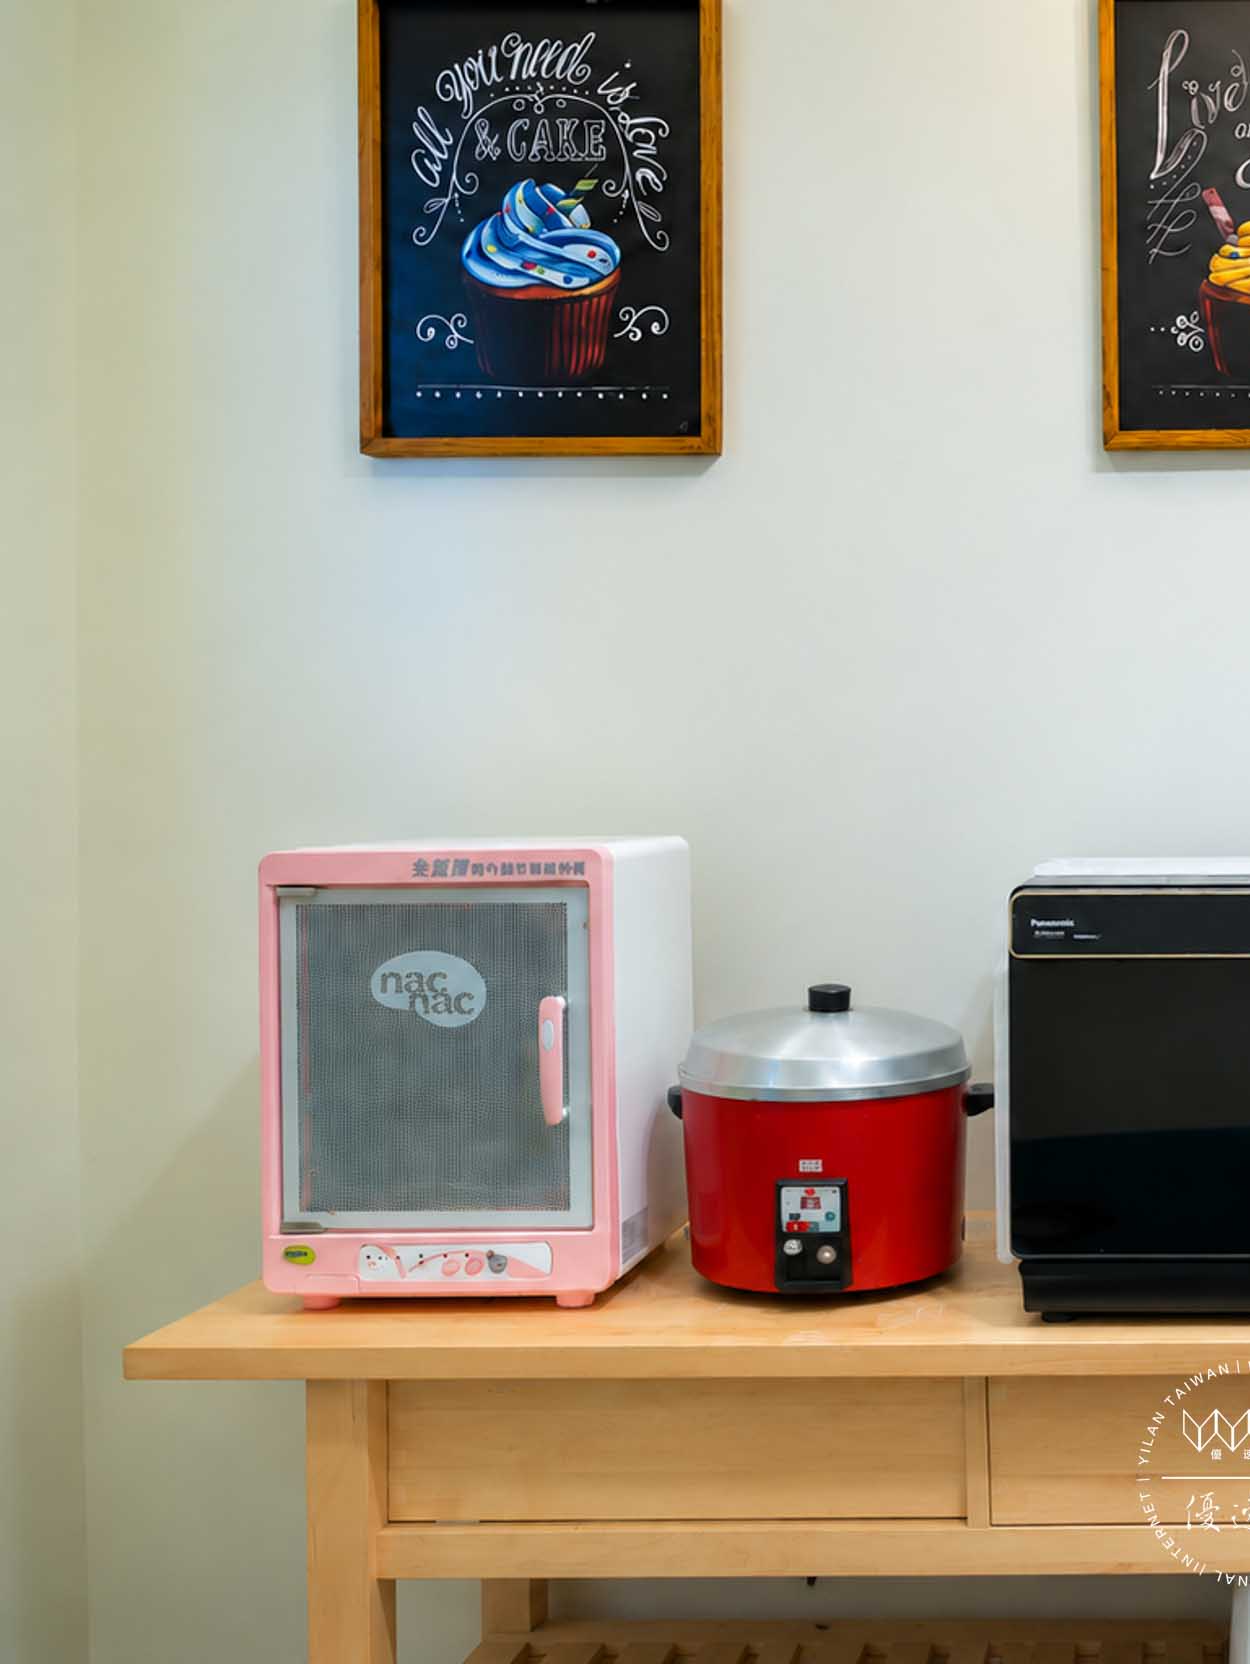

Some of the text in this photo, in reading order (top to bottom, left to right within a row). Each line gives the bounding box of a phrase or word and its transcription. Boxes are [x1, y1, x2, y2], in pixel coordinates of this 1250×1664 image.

[436, 45, 503, 120] you
[501, 32, 596, 85] need
[474, 118, 606, 162] & CAKE
[380, 971, 447, 994] nac
[408, 991, 475, 1015] nac
